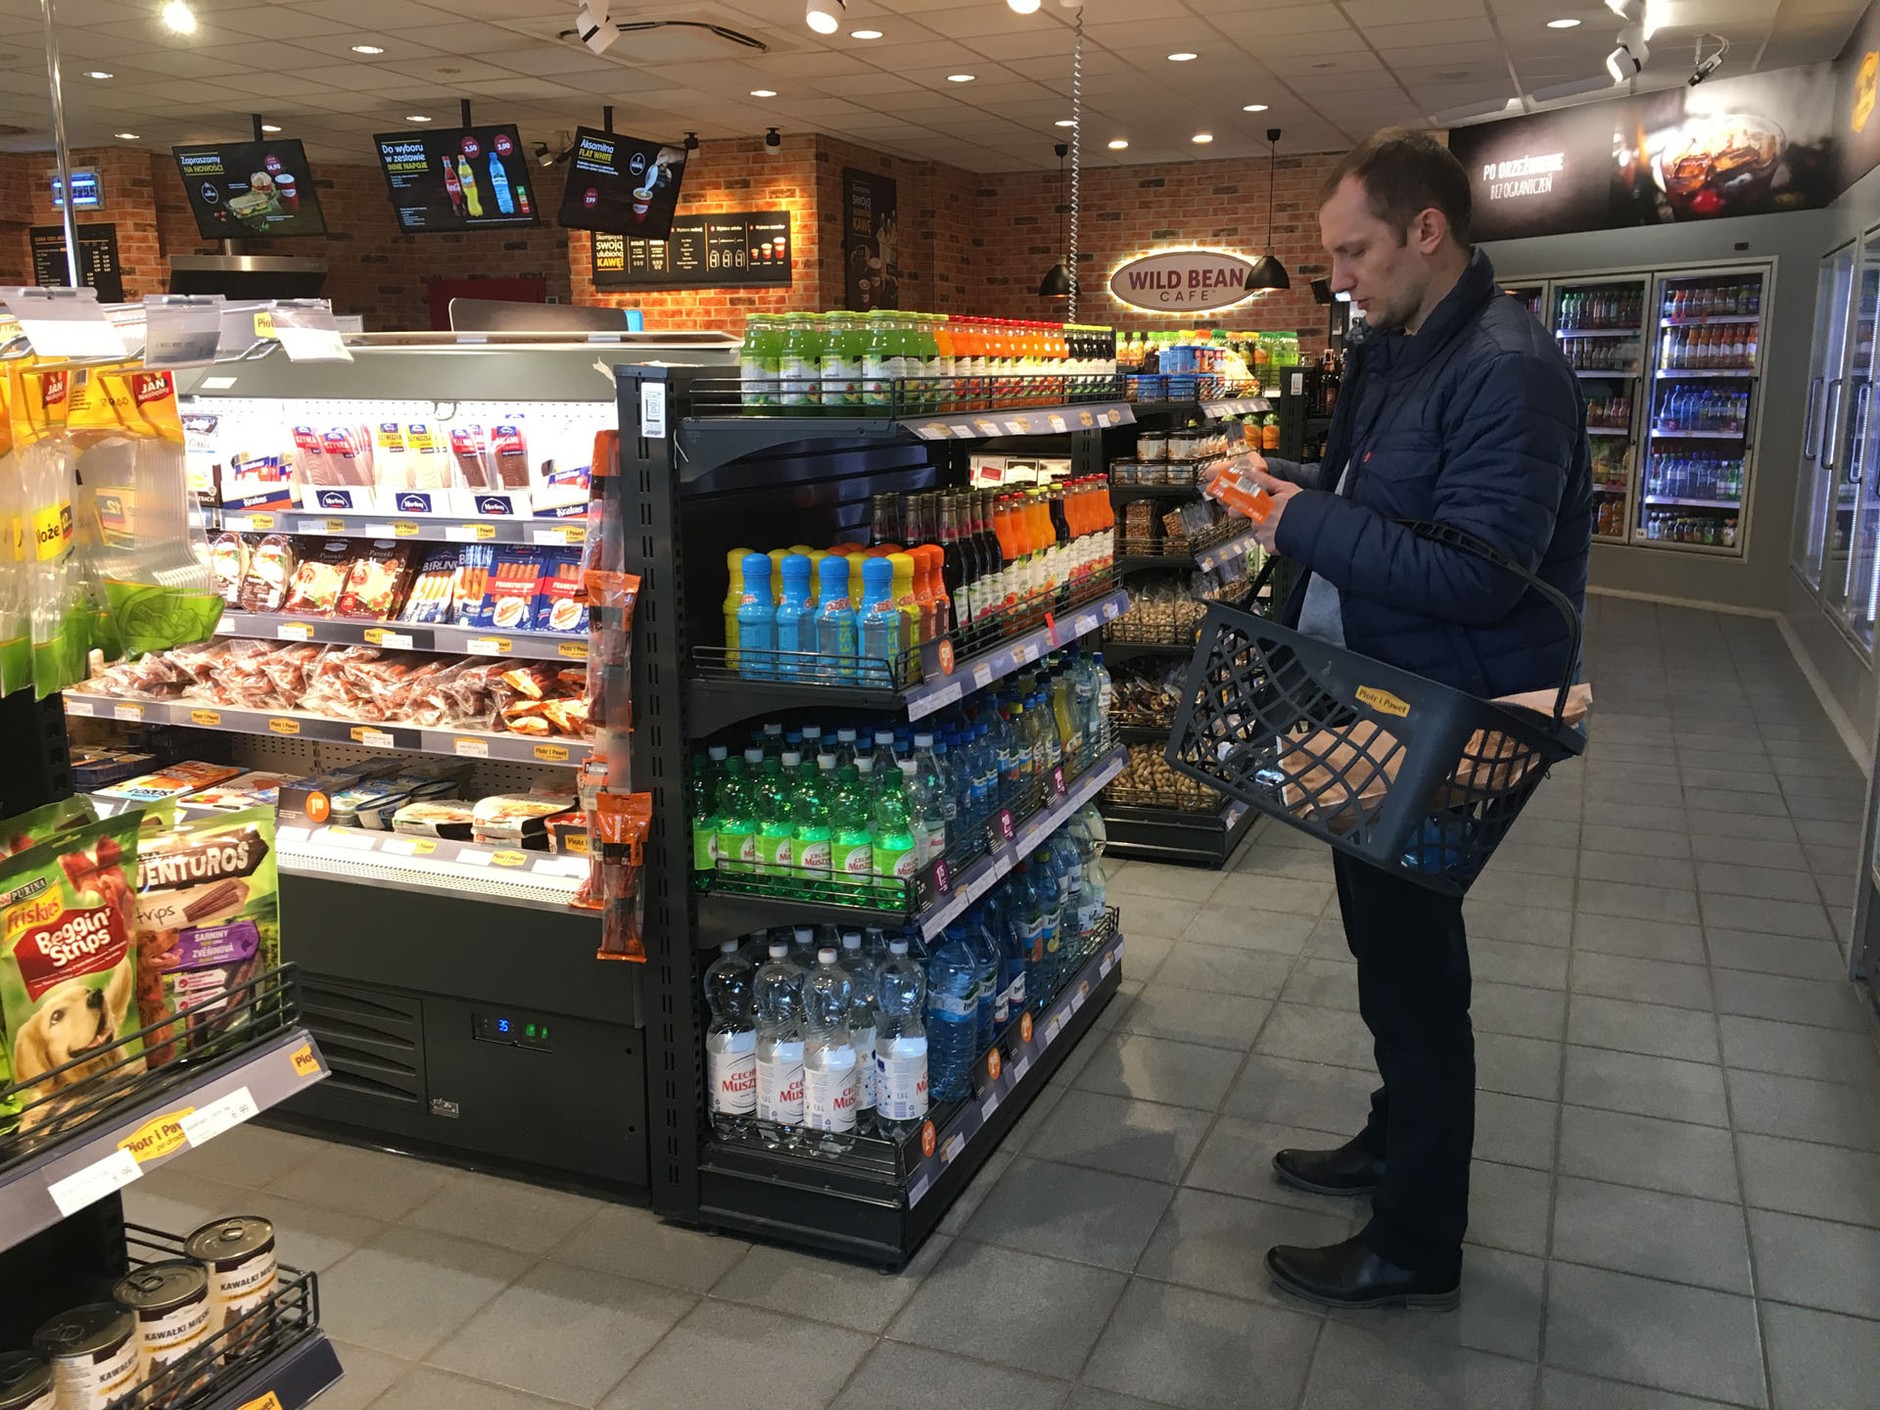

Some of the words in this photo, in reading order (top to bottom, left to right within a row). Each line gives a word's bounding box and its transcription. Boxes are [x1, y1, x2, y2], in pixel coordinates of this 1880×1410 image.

[382, 144, 394, 154] Do
[394, 143, 424, 154] wyboru
[580, 138, 614, 153] Aksamitna
[180, 156, 220, 166] Zapraszamy
[393, 153, 426, 162] zestawie
[578, 148, 593, 158] FLAT
[594, 151, 612, 162] WHITE
[403, 161, 428, 170] NAPOJE
[1483, 164, 1496, 180] PO
[1490, 183, 1503, 200] BEZ
[596, 240, 623, 251] swoją
[596, 250, 624, 258] ulubioną
[597, 257, 624, 268] KAWĘ!
[1128, 270, 1182, 290] WILD
[1188, 268, 1244, 288] BEAN
[1160, 290, 1208, 302] CAFE
[48, 381, 63, 395] JAN
[142, 378, 165, 393] JAN
[556, 506, 584, 517] Krakus
[1358, 688, 1378, 701] Piotr
[1384, 698, 1406, 713] Paweł
[568, 838, 584, 846] Piotr
[11, 880, 46, 901] PURINA
[7, 897, 60, 934] Friskies
[136, 904, 176, 925] trips
[35, 908, 112, 954] Beggin'
[194, 930, 228, 942] SARNINY
[49, 929, 111, 967] Strips
[295, 1054, 312, 1068] Pio
[731, 1068, 756, 1080] CECH
[789, 1080, 804, 1090] CEC
[780, 1089, 804, 1103] MUS
[220, 1273, 259, 1291] KAWAŁKI
[144, 1324, 186, 1341] KAWAŁKI
